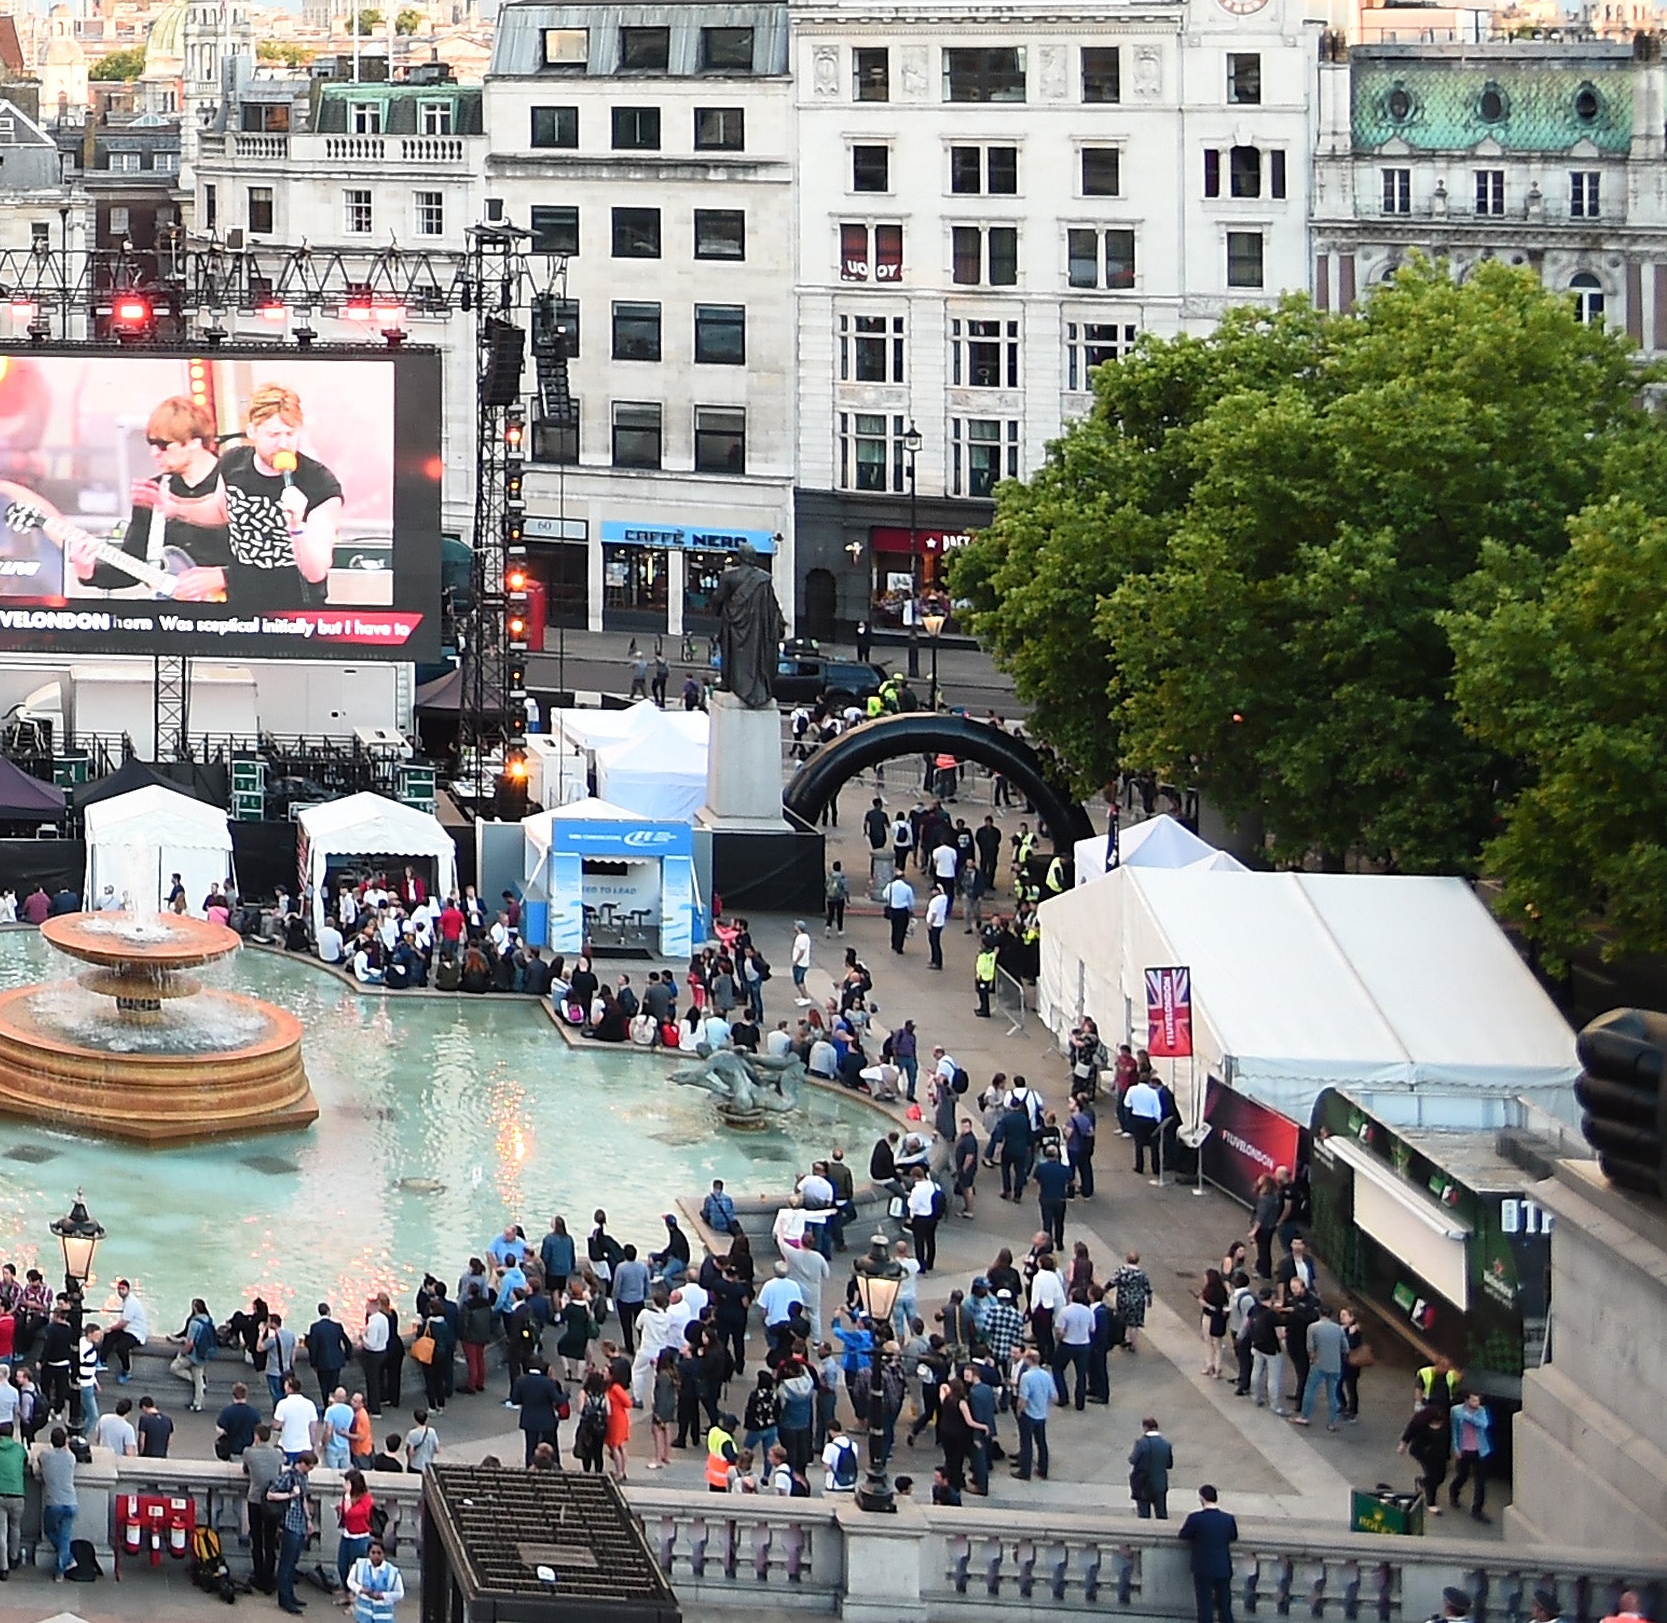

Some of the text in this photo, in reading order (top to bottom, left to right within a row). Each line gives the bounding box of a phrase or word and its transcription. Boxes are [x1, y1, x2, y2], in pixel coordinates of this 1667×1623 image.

[537, 521, 552, 531] 60
[159, 615, 194, 633] Was
[197, 616, 260, 640] sceptical
[262, 616, 314, 640] initially
[317, 618, 342, 636] but
[354, 620, 391, 638] have
[394, 623, 410, 638] to
